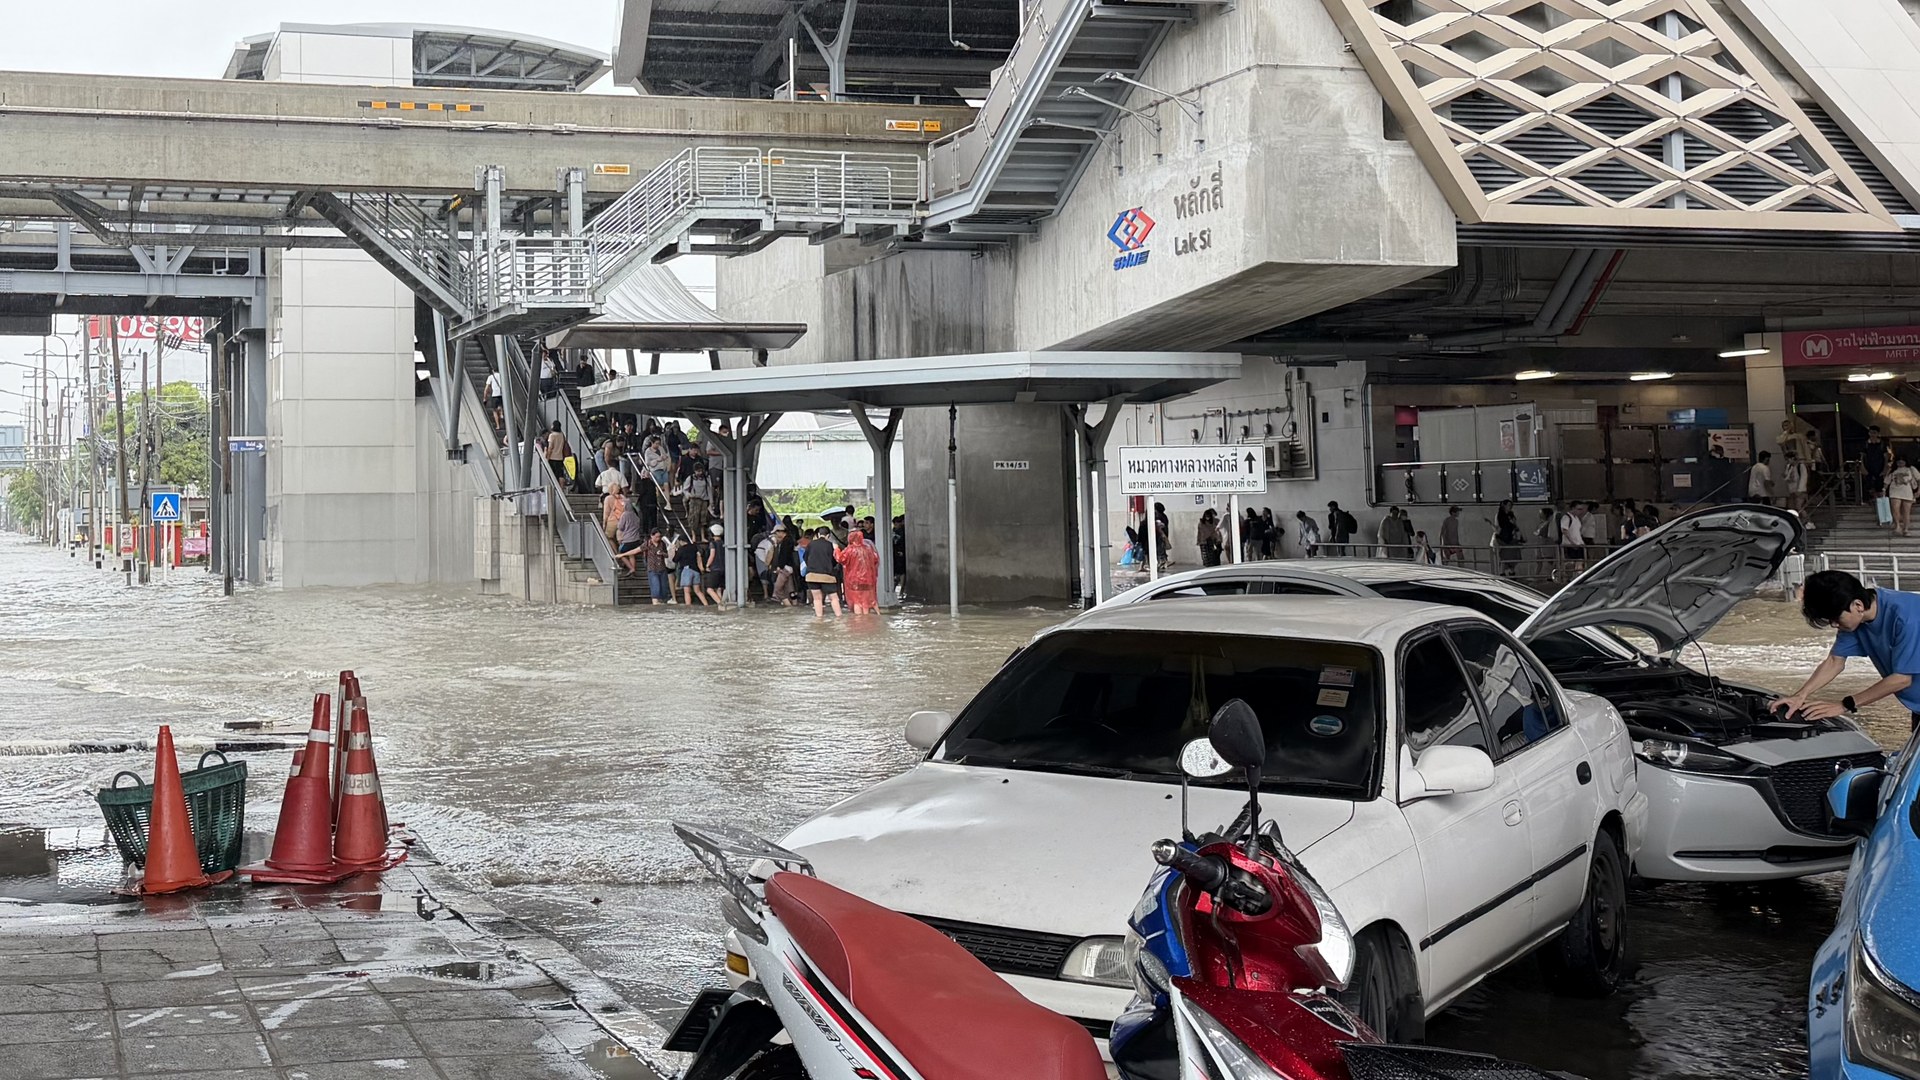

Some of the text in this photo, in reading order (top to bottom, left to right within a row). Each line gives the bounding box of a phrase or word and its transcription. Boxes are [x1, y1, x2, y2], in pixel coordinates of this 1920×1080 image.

[1173, 160, 1223, 220] หลักสี่
[1174, 227, 1212, 256] Lak Si
[1885, 349, 1909, 359] MRT
[1128, 448, 1238, 474] หมวดทางหลวงหลักสี่
[782, 972, 841, 1042] WAVE
